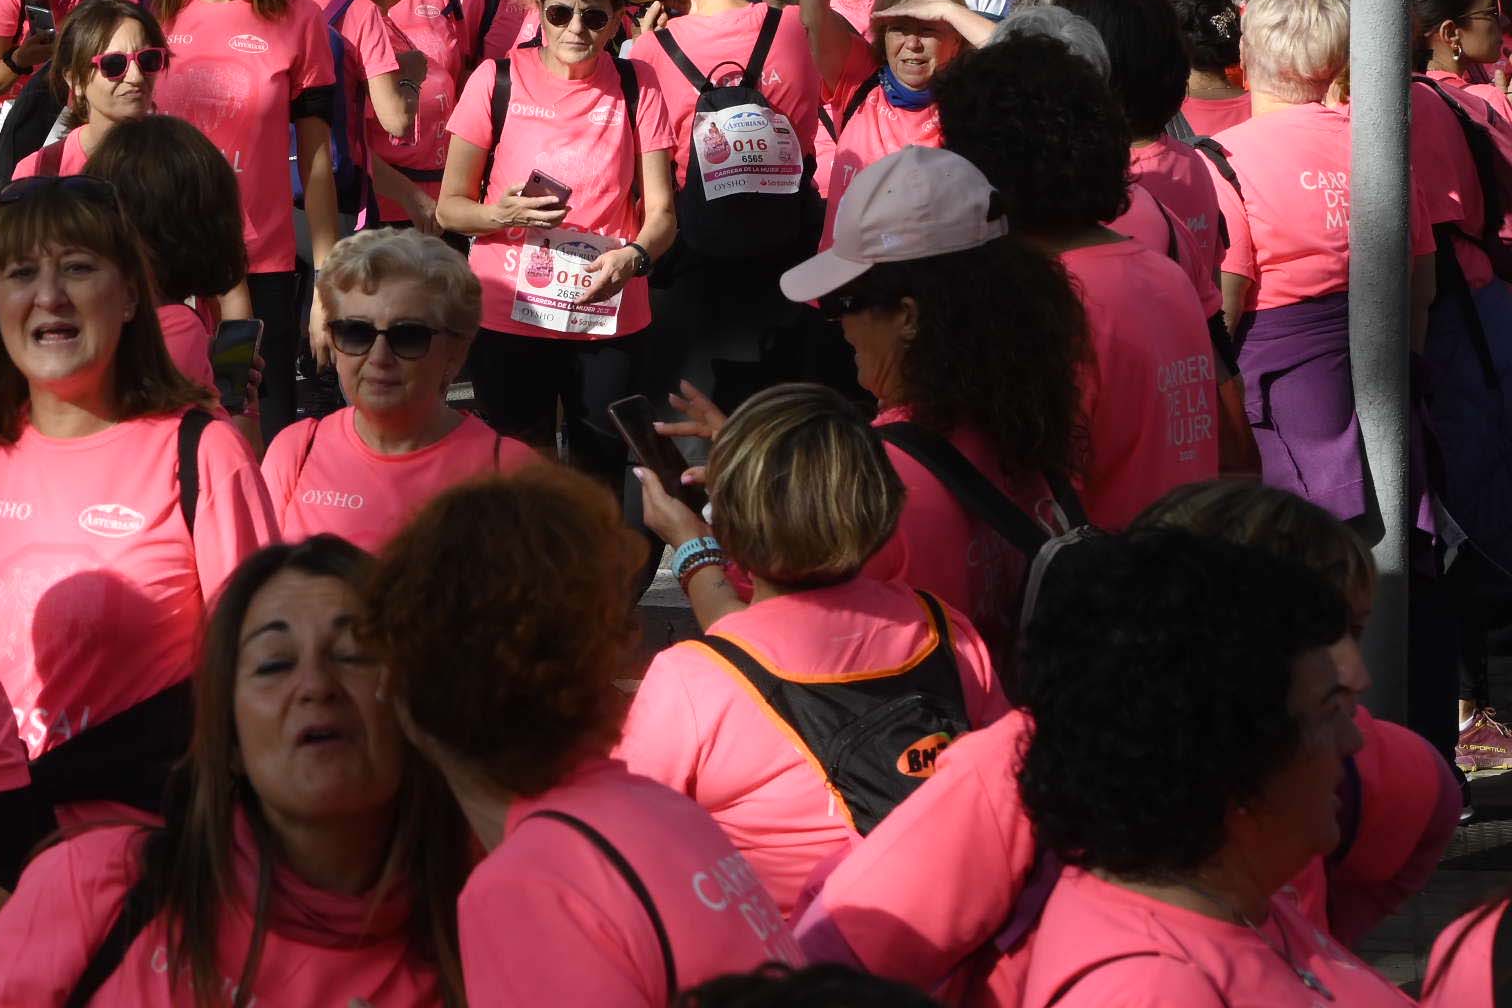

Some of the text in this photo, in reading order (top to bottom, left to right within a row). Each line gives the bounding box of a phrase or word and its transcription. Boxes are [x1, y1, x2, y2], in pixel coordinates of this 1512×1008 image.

[167, 34, 193, 45] SHO
[232, 38, 267, 50] ASTURIANA
[511, 103, 556, 119] OYSHO
[727, 120, 766, 130] ASTURIANA
[733, 139, 768, 152] 016
[714, 167, 743, 178] CARRERA
[714, 178, 746, 192] OYSHO
[556, 270, 593, 289] 016
[527, 295, 557, 307] CARRERA
[556, 289, 585, 300] 2655
[522, 307, 555, 322] OYSHO
[1156, 355, 1215, 392] CARRER
[1187, 388, 1209, 413] LA
[1168, 415, 1212, 447] UJER
[302, 489, 365, 511] OYSHO
[84, 511, 145, 533] ASTURIANA
